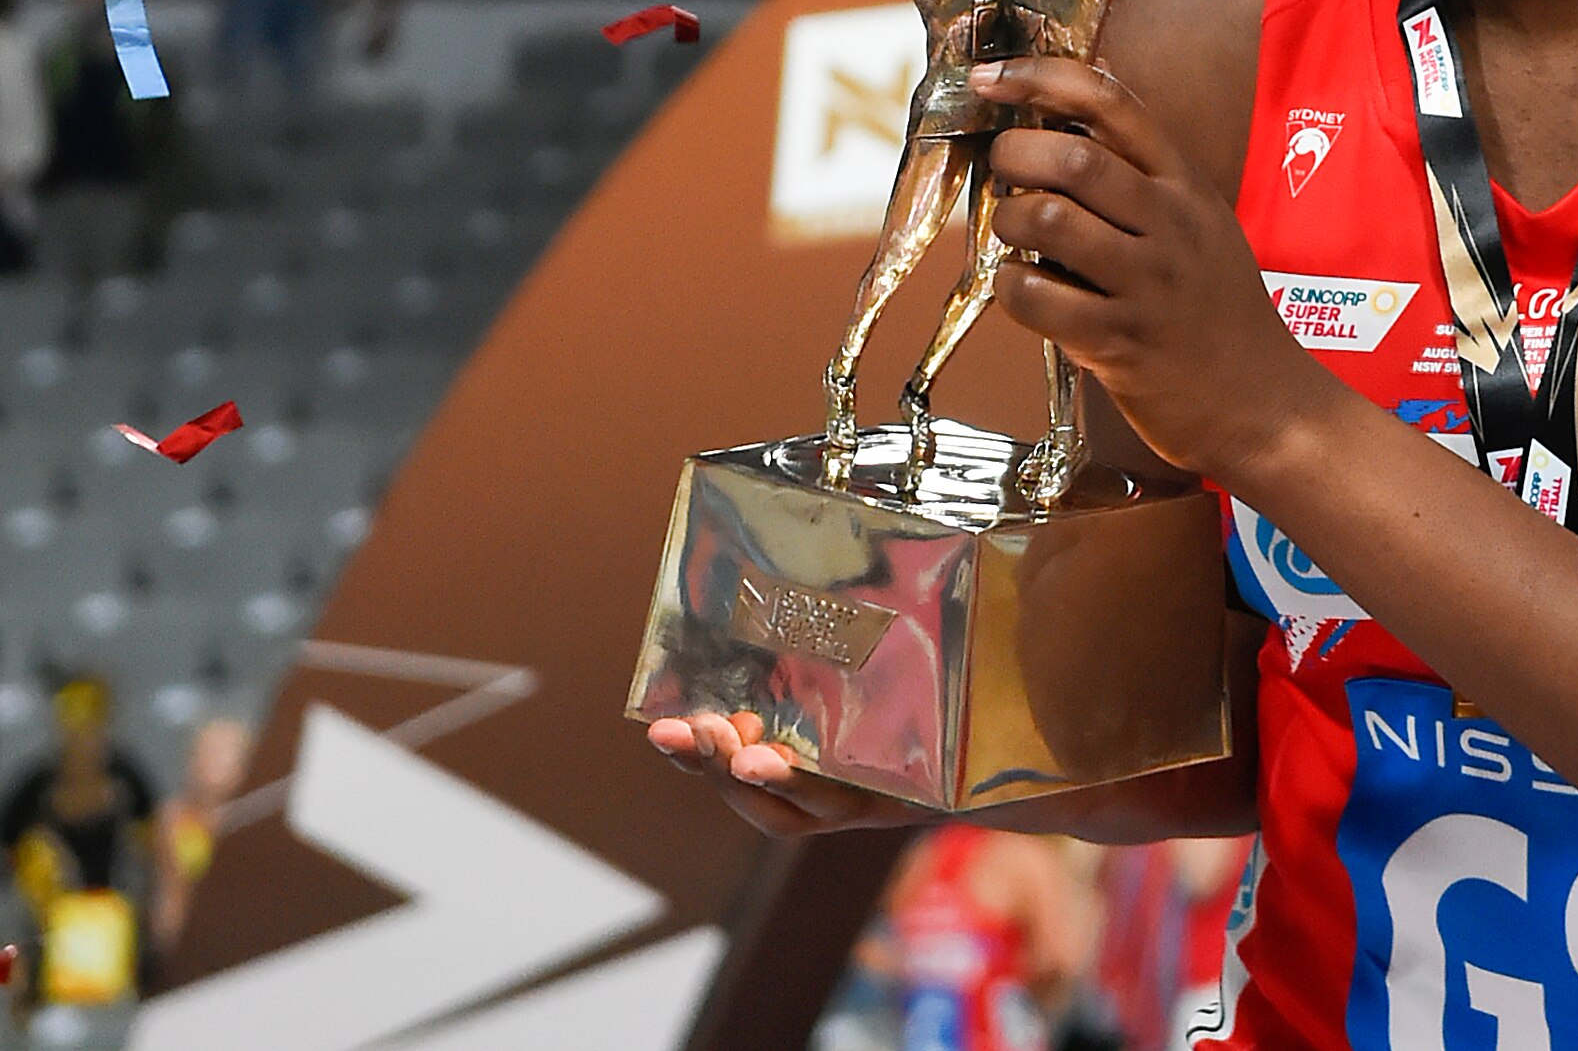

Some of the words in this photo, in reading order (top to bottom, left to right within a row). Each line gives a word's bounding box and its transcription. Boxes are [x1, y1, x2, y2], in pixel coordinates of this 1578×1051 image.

[1288, 108, 1346, 124] SYDNEY
[1288, 287, 1367, 306] SUNCORP
[1284, 304, 1341, 322] SUPER
[1422, 347, 1458, 359] AUGU
